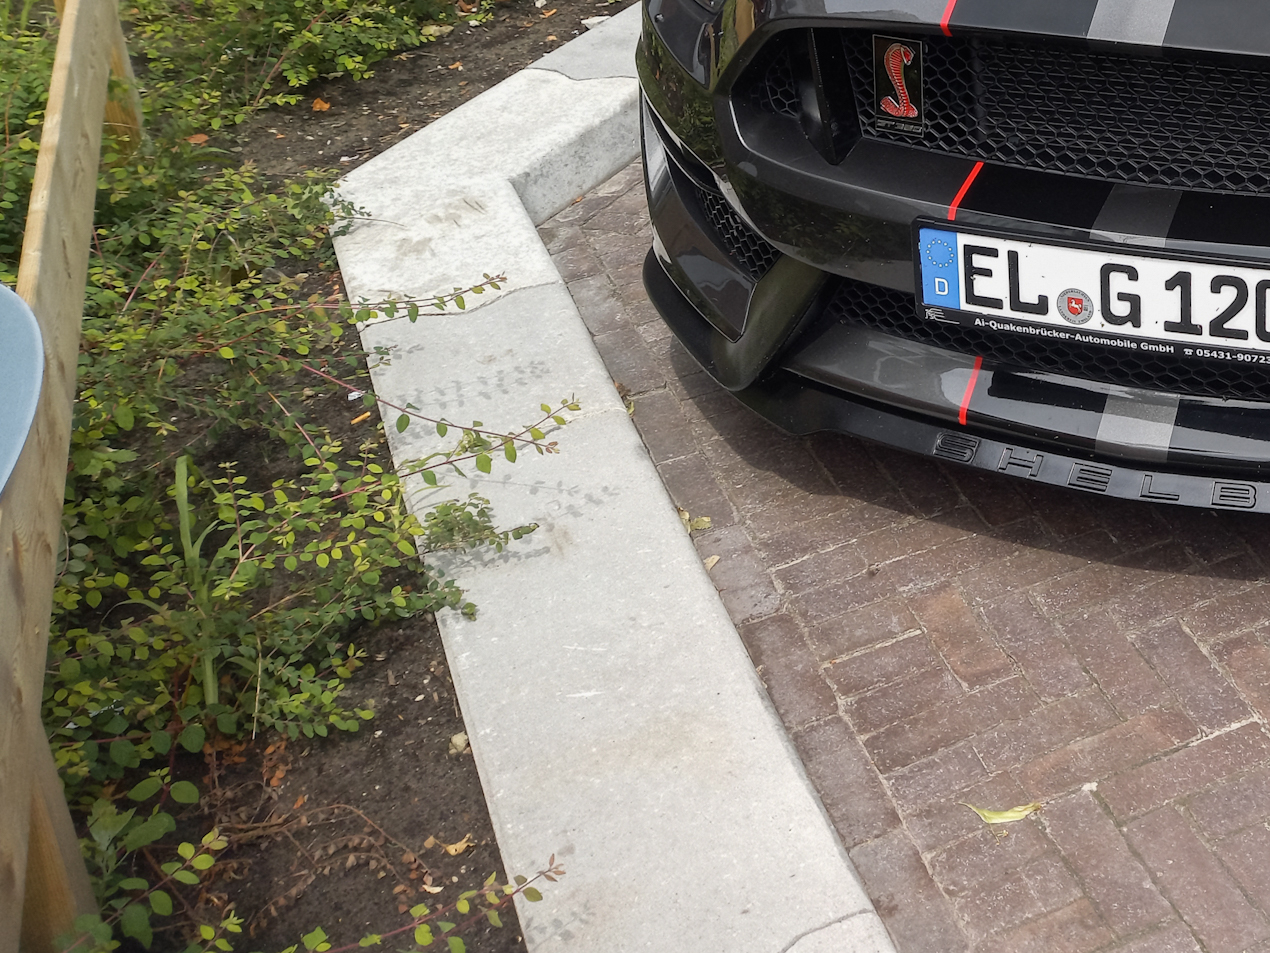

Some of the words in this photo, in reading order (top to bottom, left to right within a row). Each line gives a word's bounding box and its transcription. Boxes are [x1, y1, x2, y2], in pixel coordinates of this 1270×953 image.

[934, 277, 949, 296] D
[963, 244, 1048, 316] EL
[1100, 263, 1141, 328] G
[974, 317, 1138, 349] Ai-Quakenbrücker-Automobile
[1140, 342, 1175, 354] GmbH
